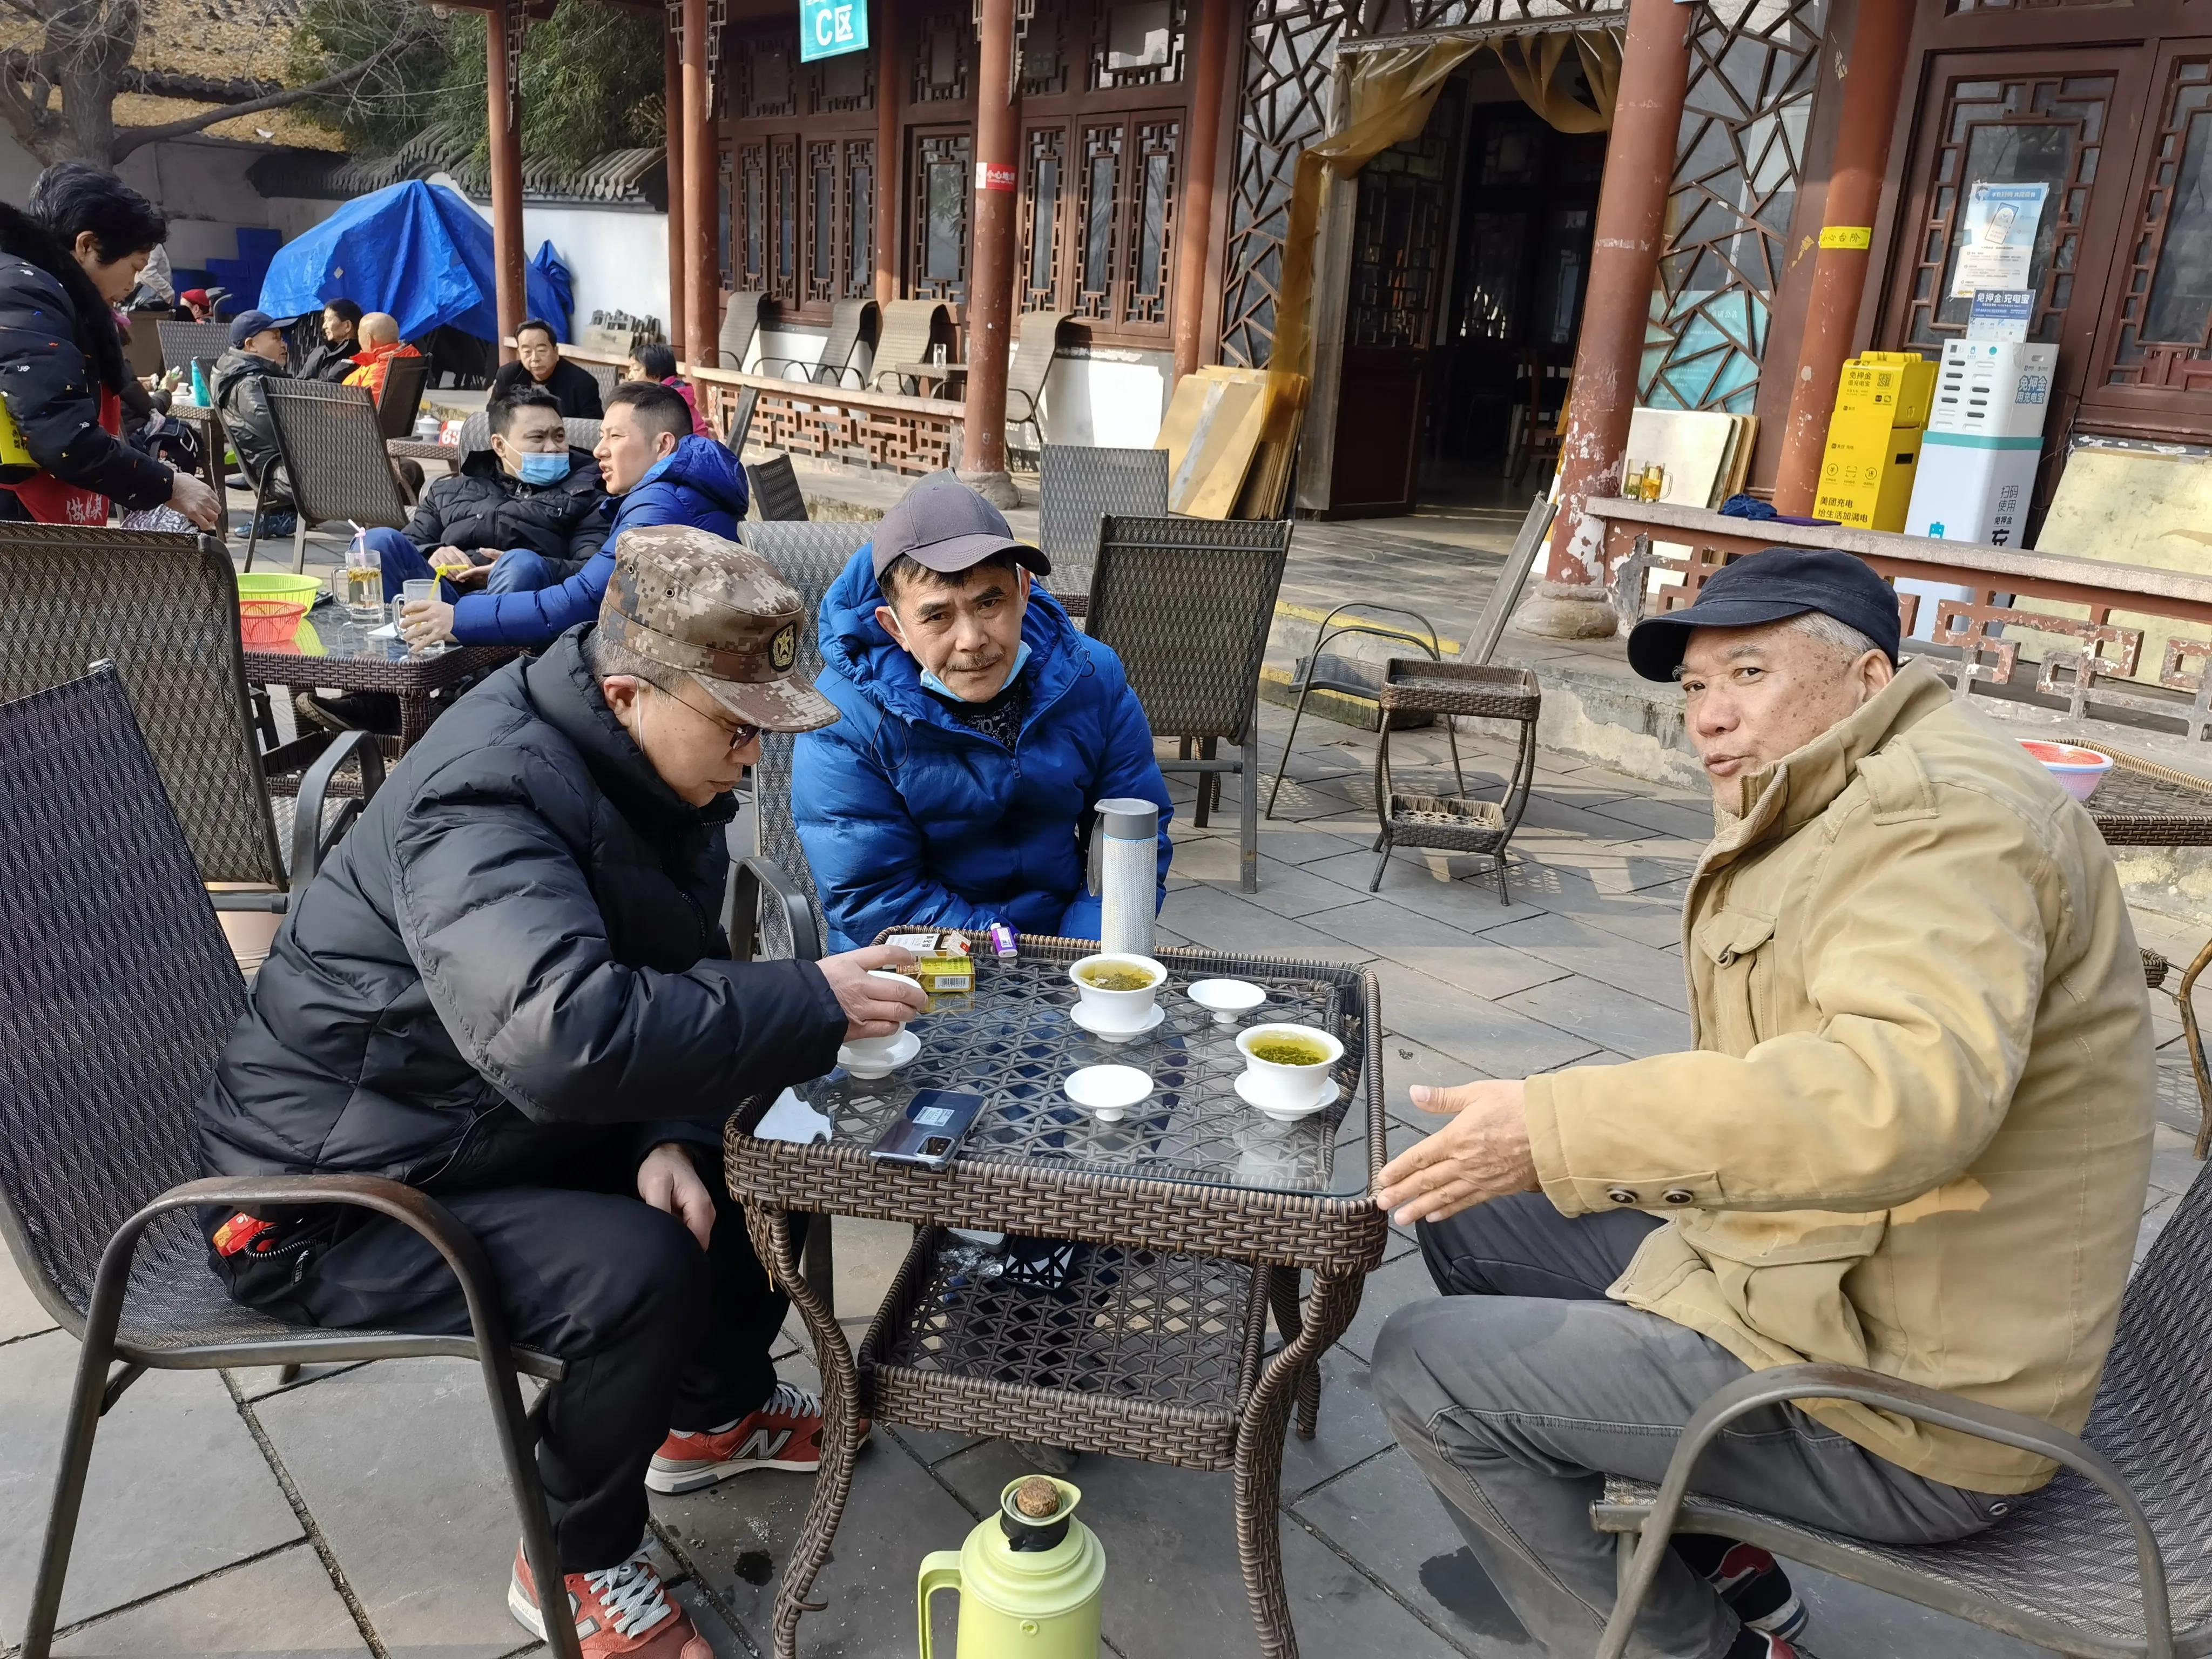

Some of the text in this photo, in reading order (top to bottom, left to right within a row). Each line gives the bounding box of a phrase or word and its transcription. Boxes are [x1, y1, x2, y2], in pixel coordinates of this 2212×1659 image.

[816, 4, 854, 46] C区
[1849, 372, 1872, 380] 免押金
[2019, 375, 2047, 392] 免押金
[2016, 392, 2045, 404] 用充电宝
[442, 429, 459, 446] 63
[2000, 485, 2019, 498] 扫码
[1820, 496, 1853, 508] 美团充电
[1998, 500, 2017, 512] 使用
[1818, 508, 1868, 523] 给生活加满电
[1994, 516, 2013, 525] 免押金
[729, 1429, 793, 1460] N
